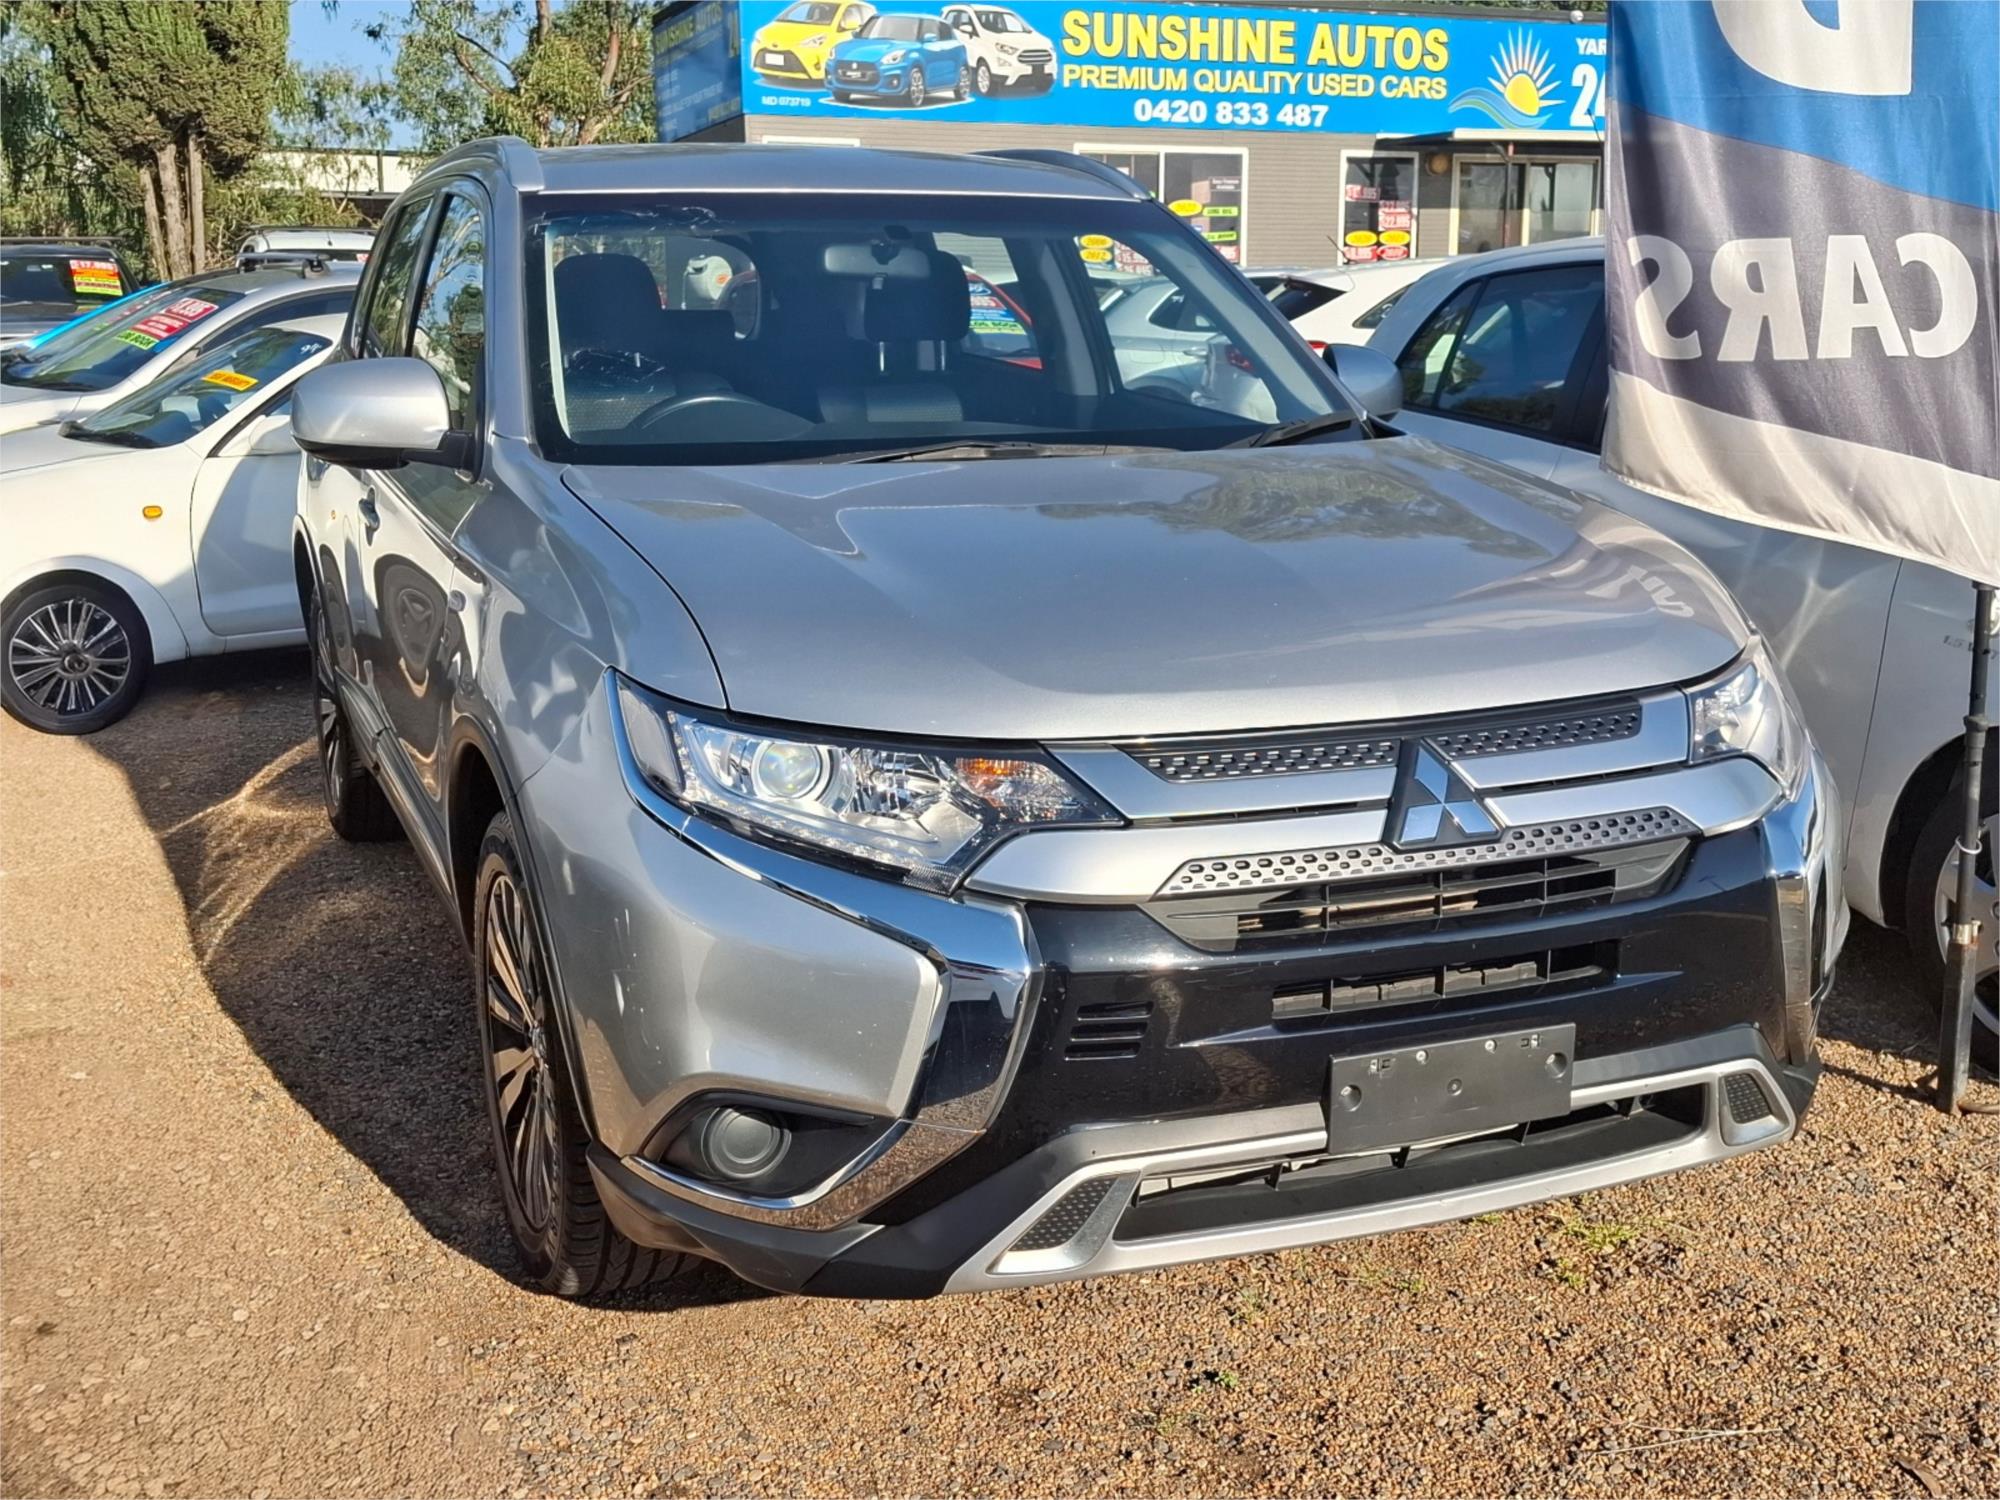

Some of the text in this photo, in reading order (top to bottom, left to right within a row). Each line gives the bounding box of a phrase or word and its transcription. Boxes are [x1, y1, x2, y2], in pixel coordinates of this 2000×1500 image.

[1062, 10, 1449, 72] SUNSHINE AUTOS
[1575, 37, 1607, 55] YAR
[1063, 64, 1447, 100] PREMIUM QUALITY USED CARS
[761, 95, 777, 106] MD
[1134, 98, 1329, 127] 0420 833 487
